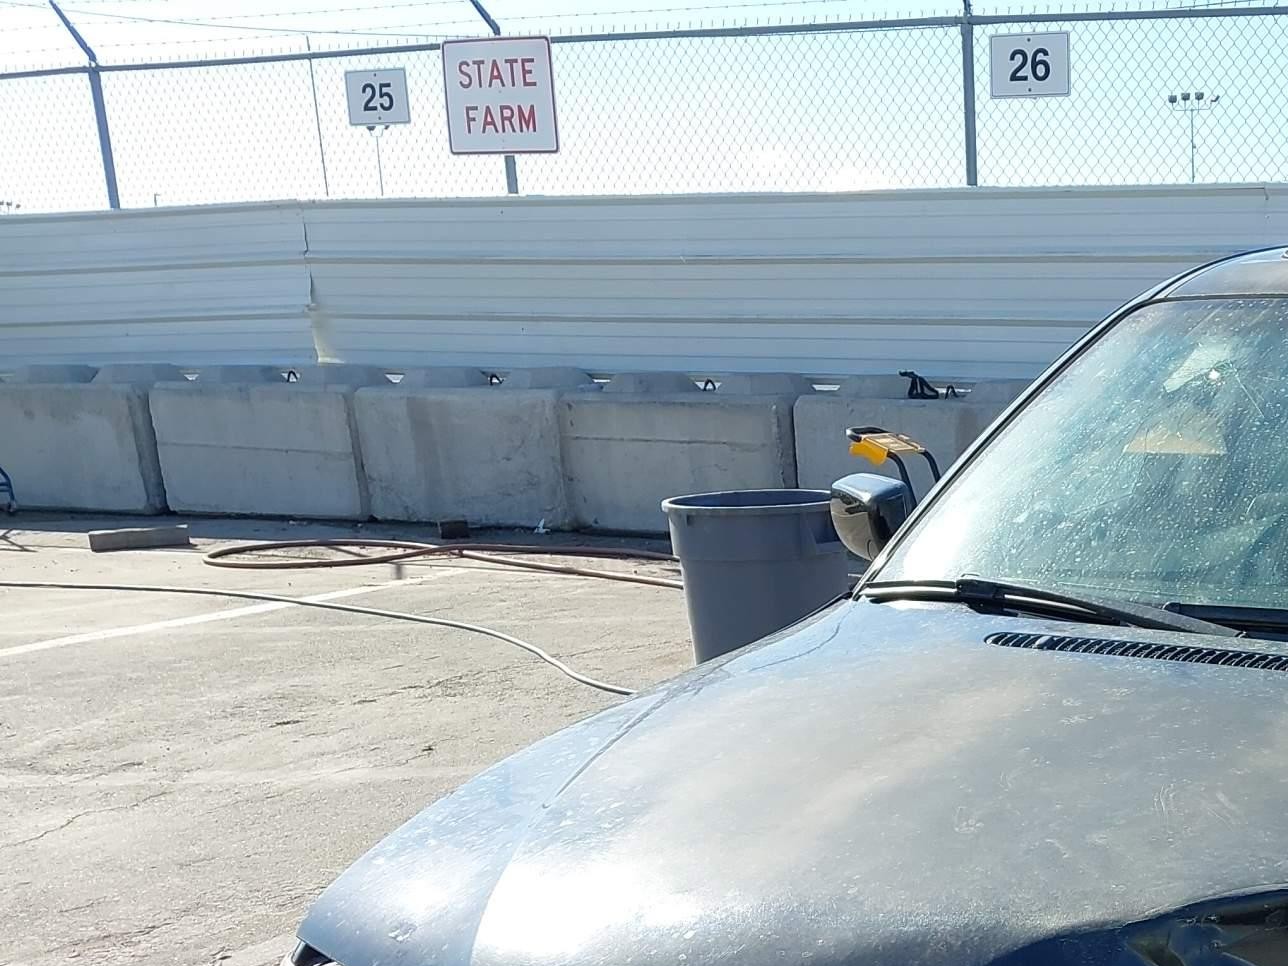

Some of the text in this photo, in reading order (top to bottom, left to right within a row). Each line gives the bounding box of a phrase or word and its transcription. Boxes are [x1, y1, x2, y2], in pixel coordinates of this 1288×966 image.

[458, 58, 537, 89] STATE
[1009, 47, 1051, 81] 26
[361, 82, 394, 112] 25
[465, 104, 537, 134] FARM
